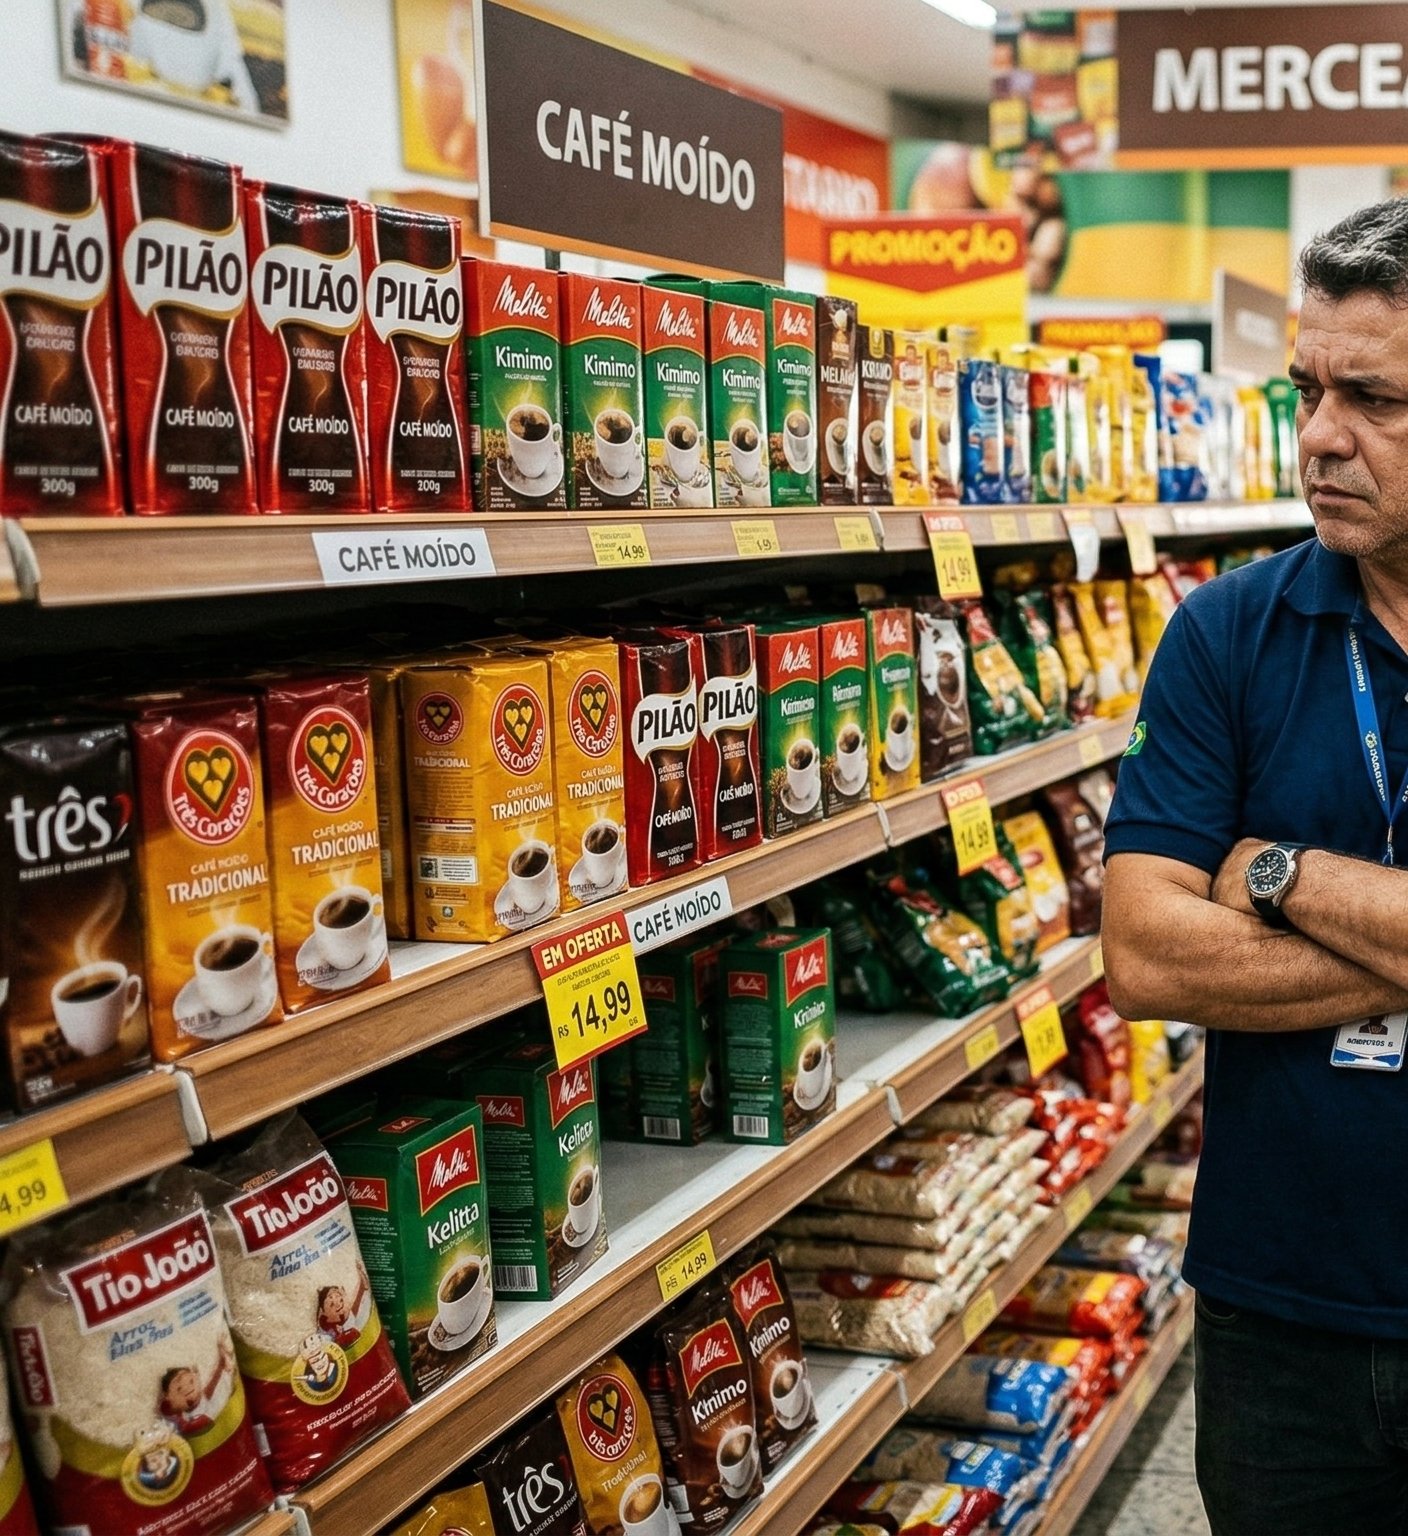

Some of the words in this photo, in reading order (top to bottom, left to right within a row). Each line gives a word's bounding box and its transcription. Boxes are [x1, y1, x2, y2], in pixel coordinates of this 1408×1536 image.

[536, 99, 634, 180] CAFÉ
[641, 129, 756, 211] MOÍDO
[135, 238, 244, 296] PILÃO
[830, 222, 1018, 272] PROMOÇÃO
[262, 261, 359, 314] PILÃO
[374, 277, 461, 326] PILÃO
[495, 346, 553, 372] Kimimo
[584, 354, 636, 379] Kimimo
[657, 362, 700, 385] Kimimo
[722, 369, 761, 389] Kimimo
[15, 403, 47, 424] CAFÉ
[50, 403, 93, 425] MOÍDO
[166, 406, 195, 426] CAFÉ
[197, 407, 234, 428] MOÍDO
[288, 414, 315, 433] CAFÉ
[400, 420, 422, 437] CAFÉ
[423, 420, 452, 438] MOÍDO
[41, 478, 76, 496] 300g
[189, 476, 219, 493] 300g
[308, 479, 335, 495] 300g
[339, 539, 400, 572] CAFÉ
[402, 537, 476, 569] MOÍDO
[638, 700, 696, 744] PILÃO
[703, 681, 755, 723] PILÃO
[5, 785, 112, 862] três
[292, 830, 379, 865] TRADICIONAL
[167, 864, 269, 904] TRADICIONAL
[634, 903, 674, 943] CAFÉ
[674, 890, 721, 927] MOÍDO
[541, 945, 564, 970] EM
[565, 920, 623, 959] OFERTA
[571, 980, 632, 1038] 14,99
[243, 1204, 288, 1239] Tio
[281, 1176, 339, 1222] João
[427, 1202, 480, 1249] Kelitta
[83, 1272, 142, 1312] Tio
[143, 1238, 209, 1289] João
[502, 1462, 565, 1533] três
